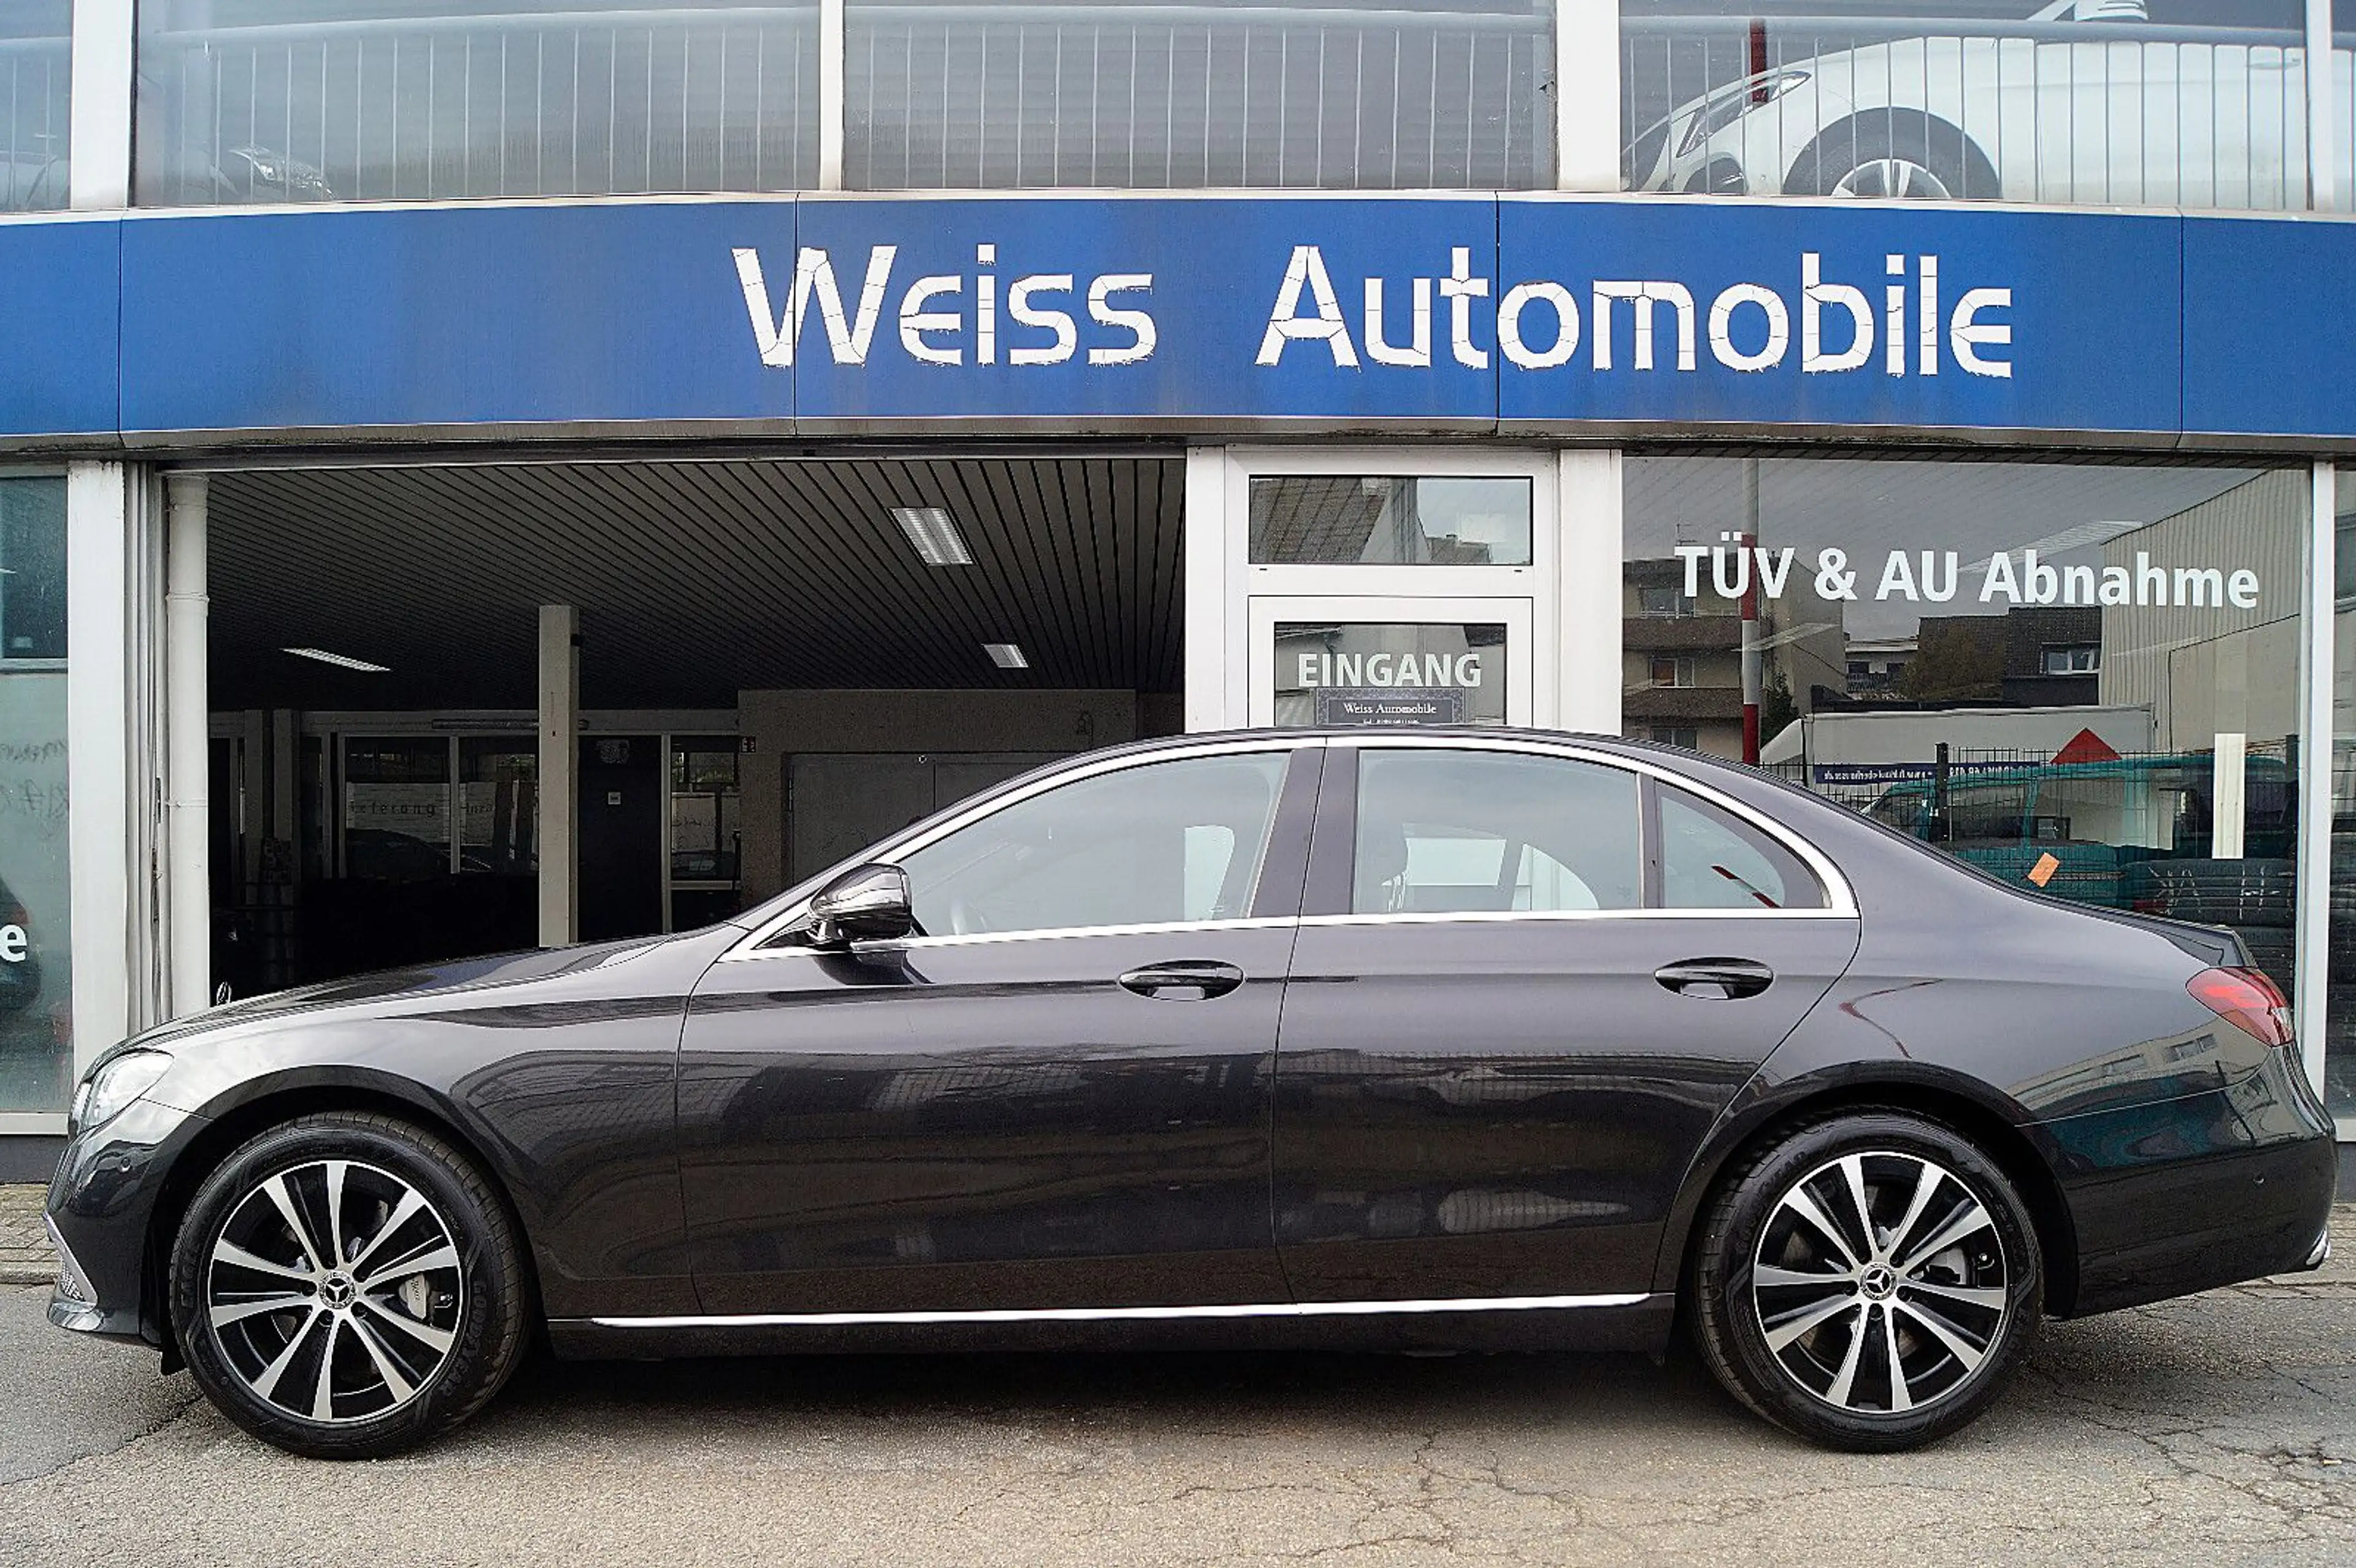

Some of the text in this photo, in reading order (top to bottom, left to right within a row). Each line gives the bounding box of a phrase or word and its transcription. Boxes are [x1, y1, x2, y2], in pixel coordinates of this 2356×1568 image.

[731, 244, 2011, 378] Weiss Automobile
[1673, 531, 2259, 609] TÜV & AU Abnahme
[1298, 653, 1481, 688] EINGANG
[1344, 702, 1437, 715] Weiss Automobile
